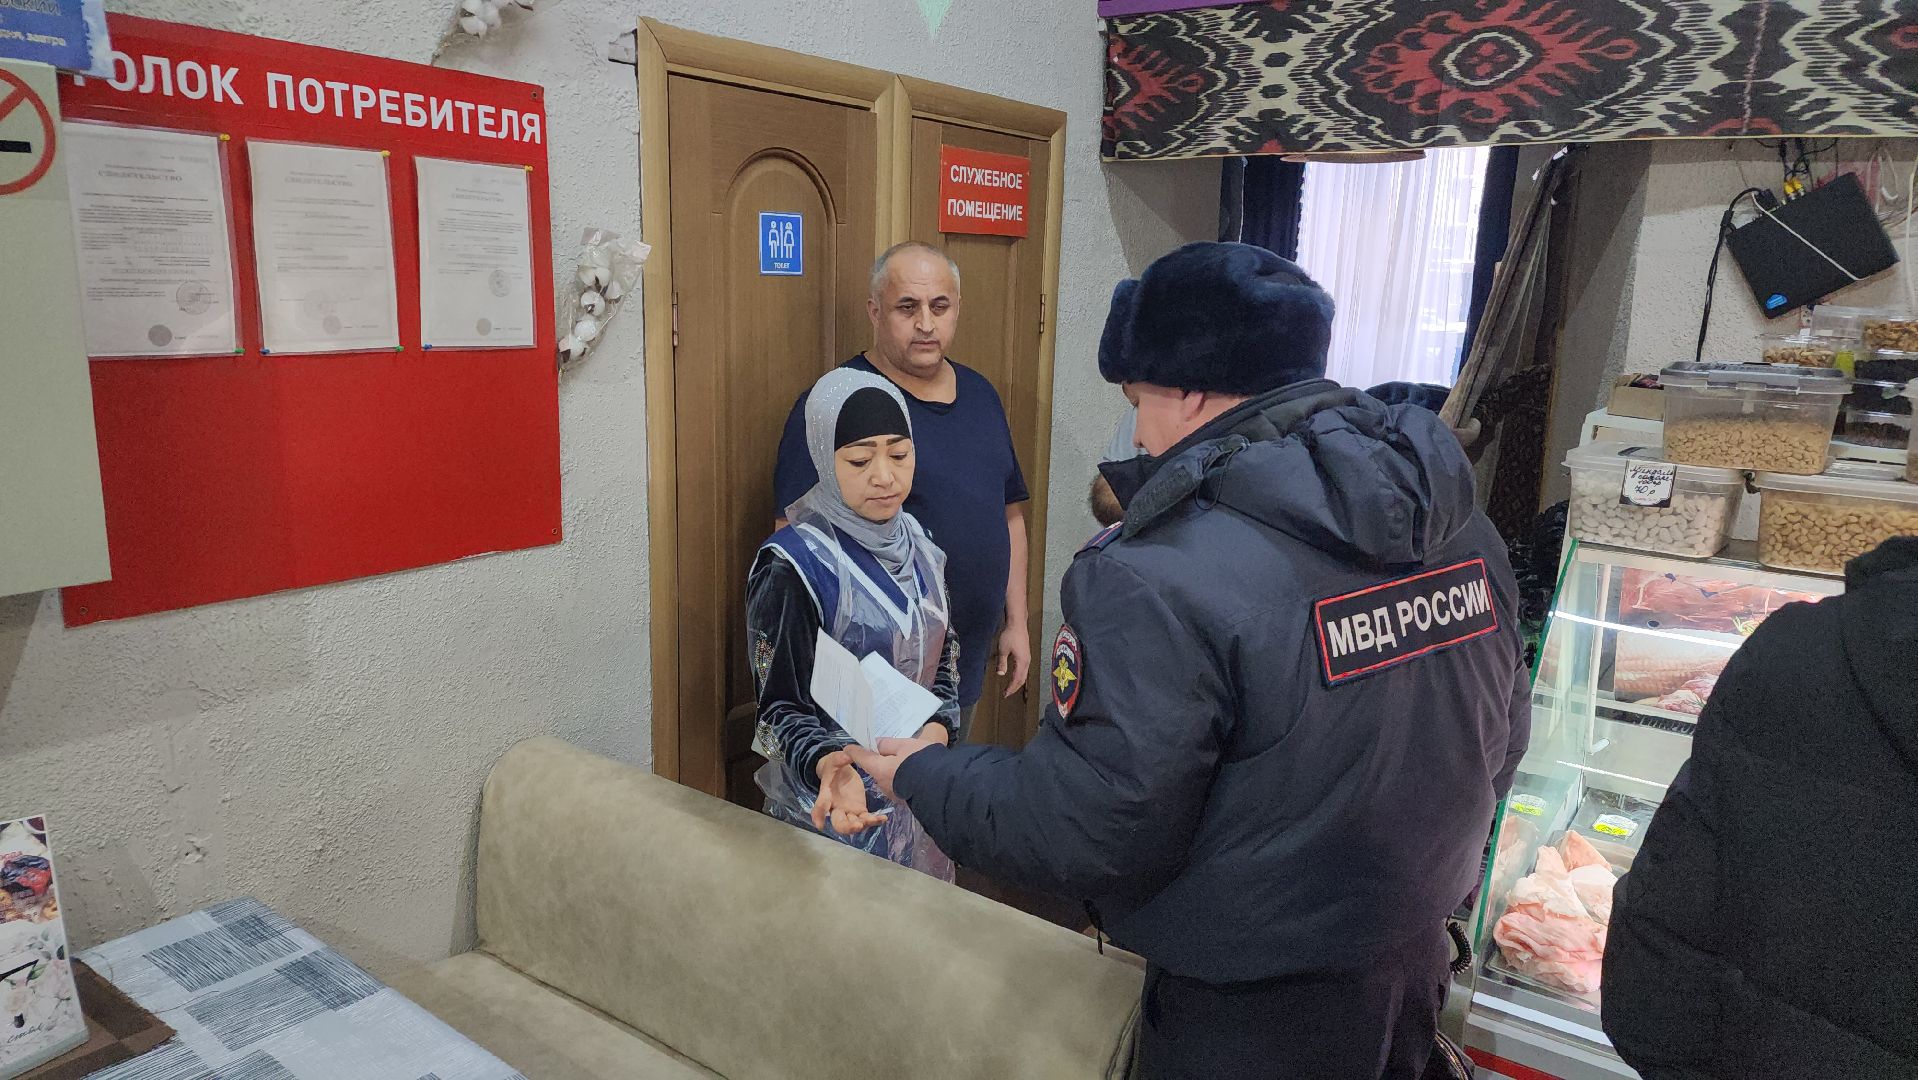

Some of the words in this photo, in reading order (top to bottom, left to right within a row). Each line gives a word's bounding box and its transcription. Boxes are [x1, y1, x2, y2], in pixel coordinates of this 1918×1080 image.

[74, 51, 244, 105] ОЛОК
[266, 71, 541, 144] ПОТРЕБИТЕЛЯ
[950, 165, 1023, 190] СЛУЖЕБНОЕ
[947, 198, 1023, 222] ПОМЕЩЕНИЕ
[1326, 606, 1398, 658] МВД
[1396, 578, 1491, 637] РОССИИ
